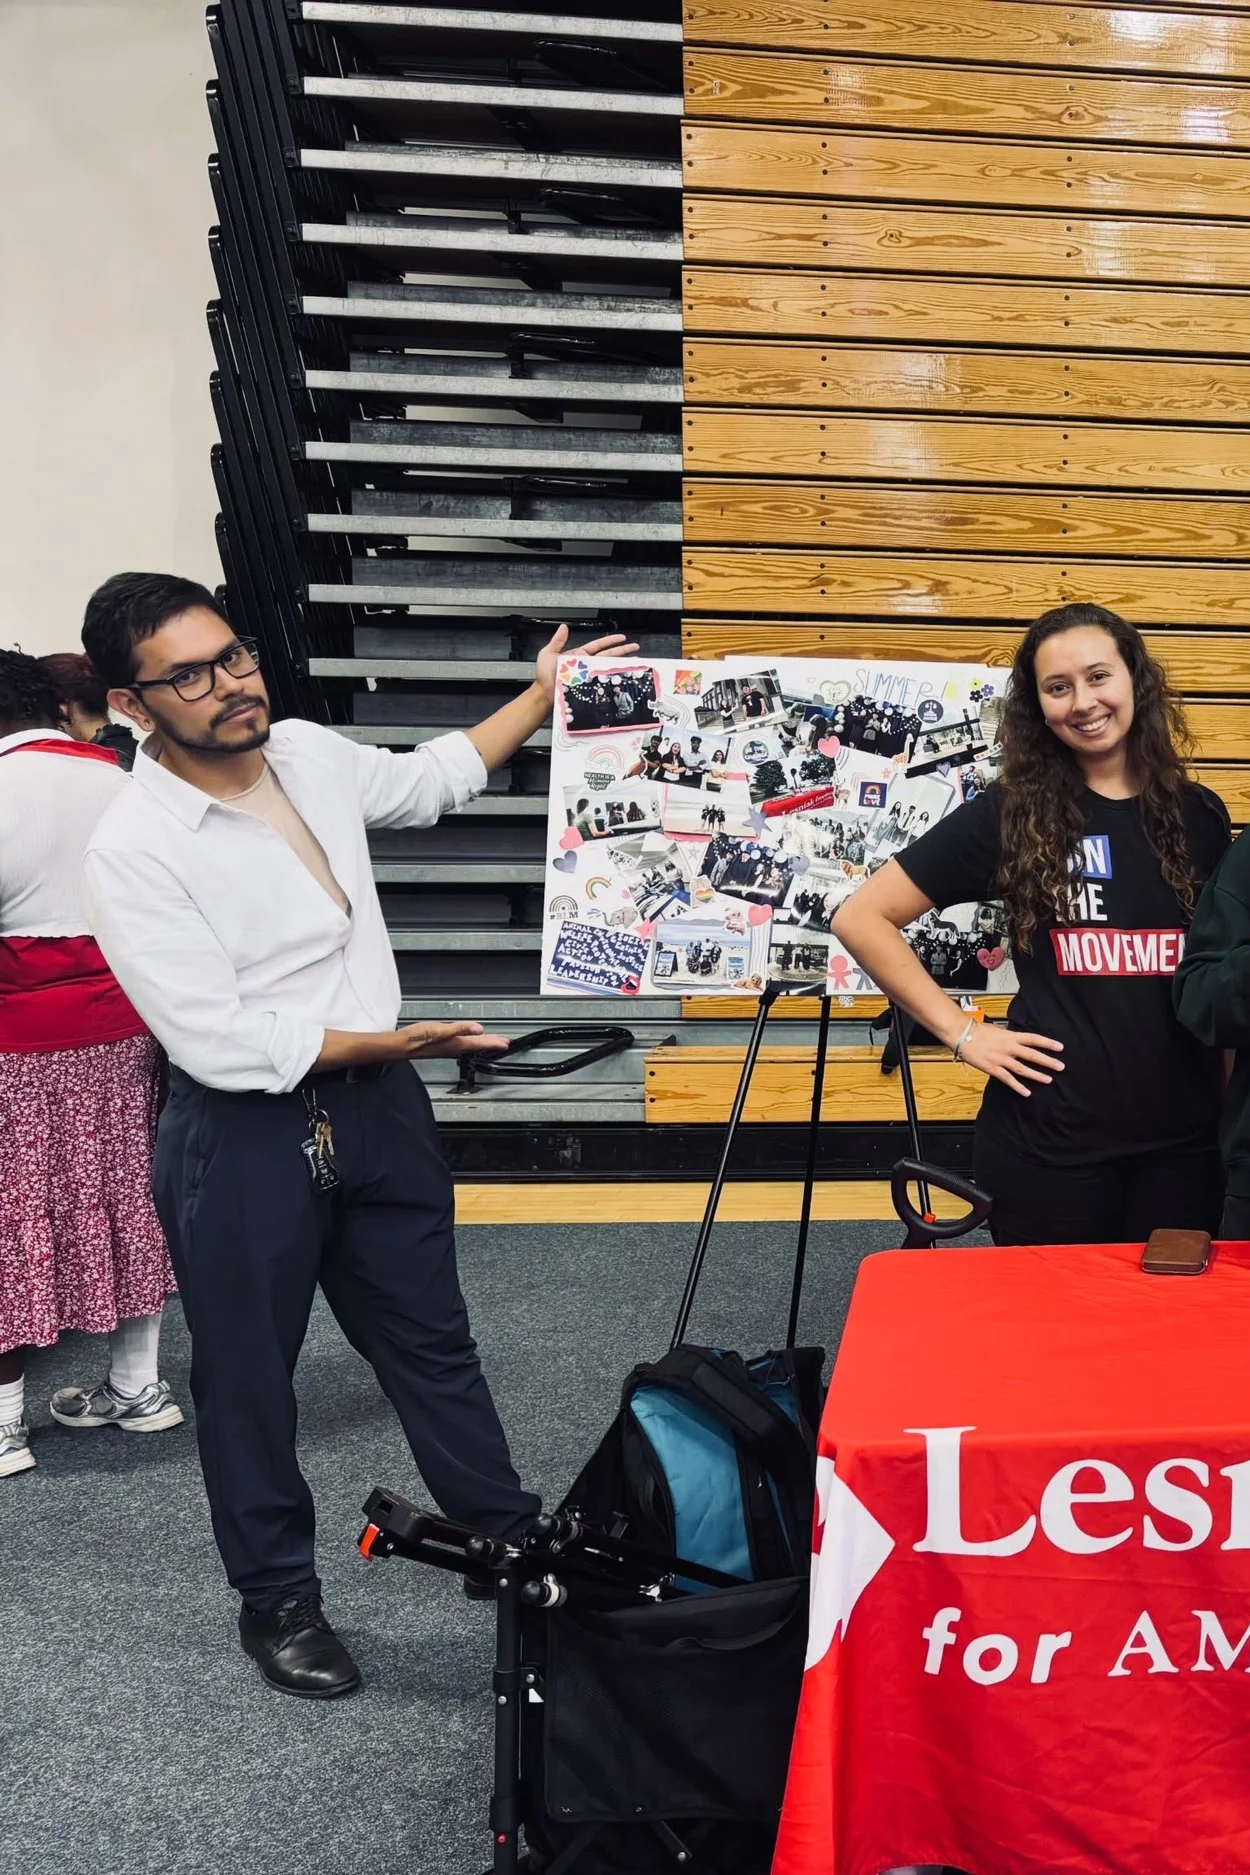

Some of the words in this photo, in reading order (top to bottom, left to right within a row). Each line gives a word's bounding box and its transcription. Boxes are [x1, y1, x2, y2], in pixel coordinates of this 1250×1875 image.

[563, 922, 592, 933] ANIMAL
[558, 943, 594, 962] ACTION
[549, 964, 609, 985] LEADERSHIP
[923, 1607, 1072, 1686] for
